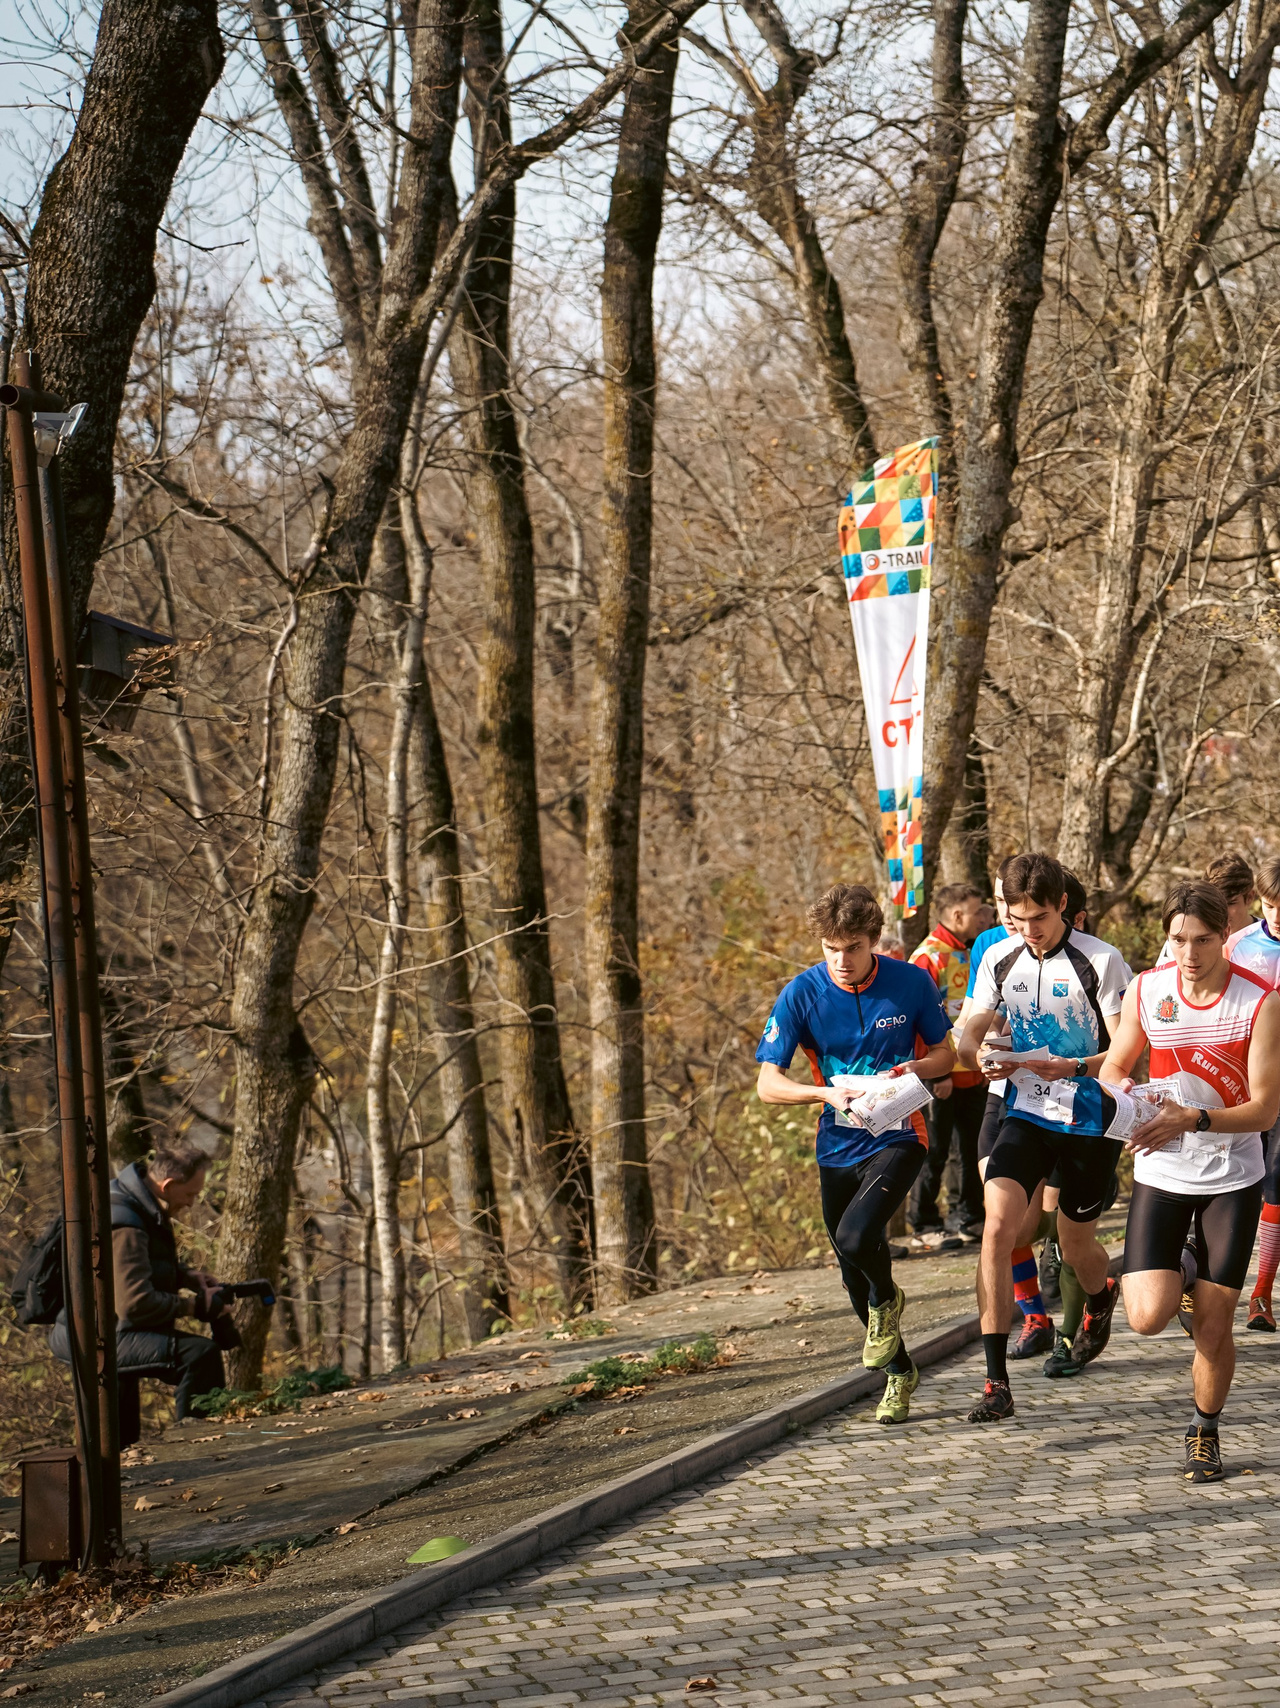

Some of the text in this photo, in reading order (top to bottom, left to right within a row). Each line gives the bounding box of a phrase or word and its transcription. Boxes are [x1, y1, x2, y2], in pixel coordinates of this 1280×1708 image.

[1190, 1051, 1242, 1096] Run and
[1034, 1084, 1050, 1097] 34
